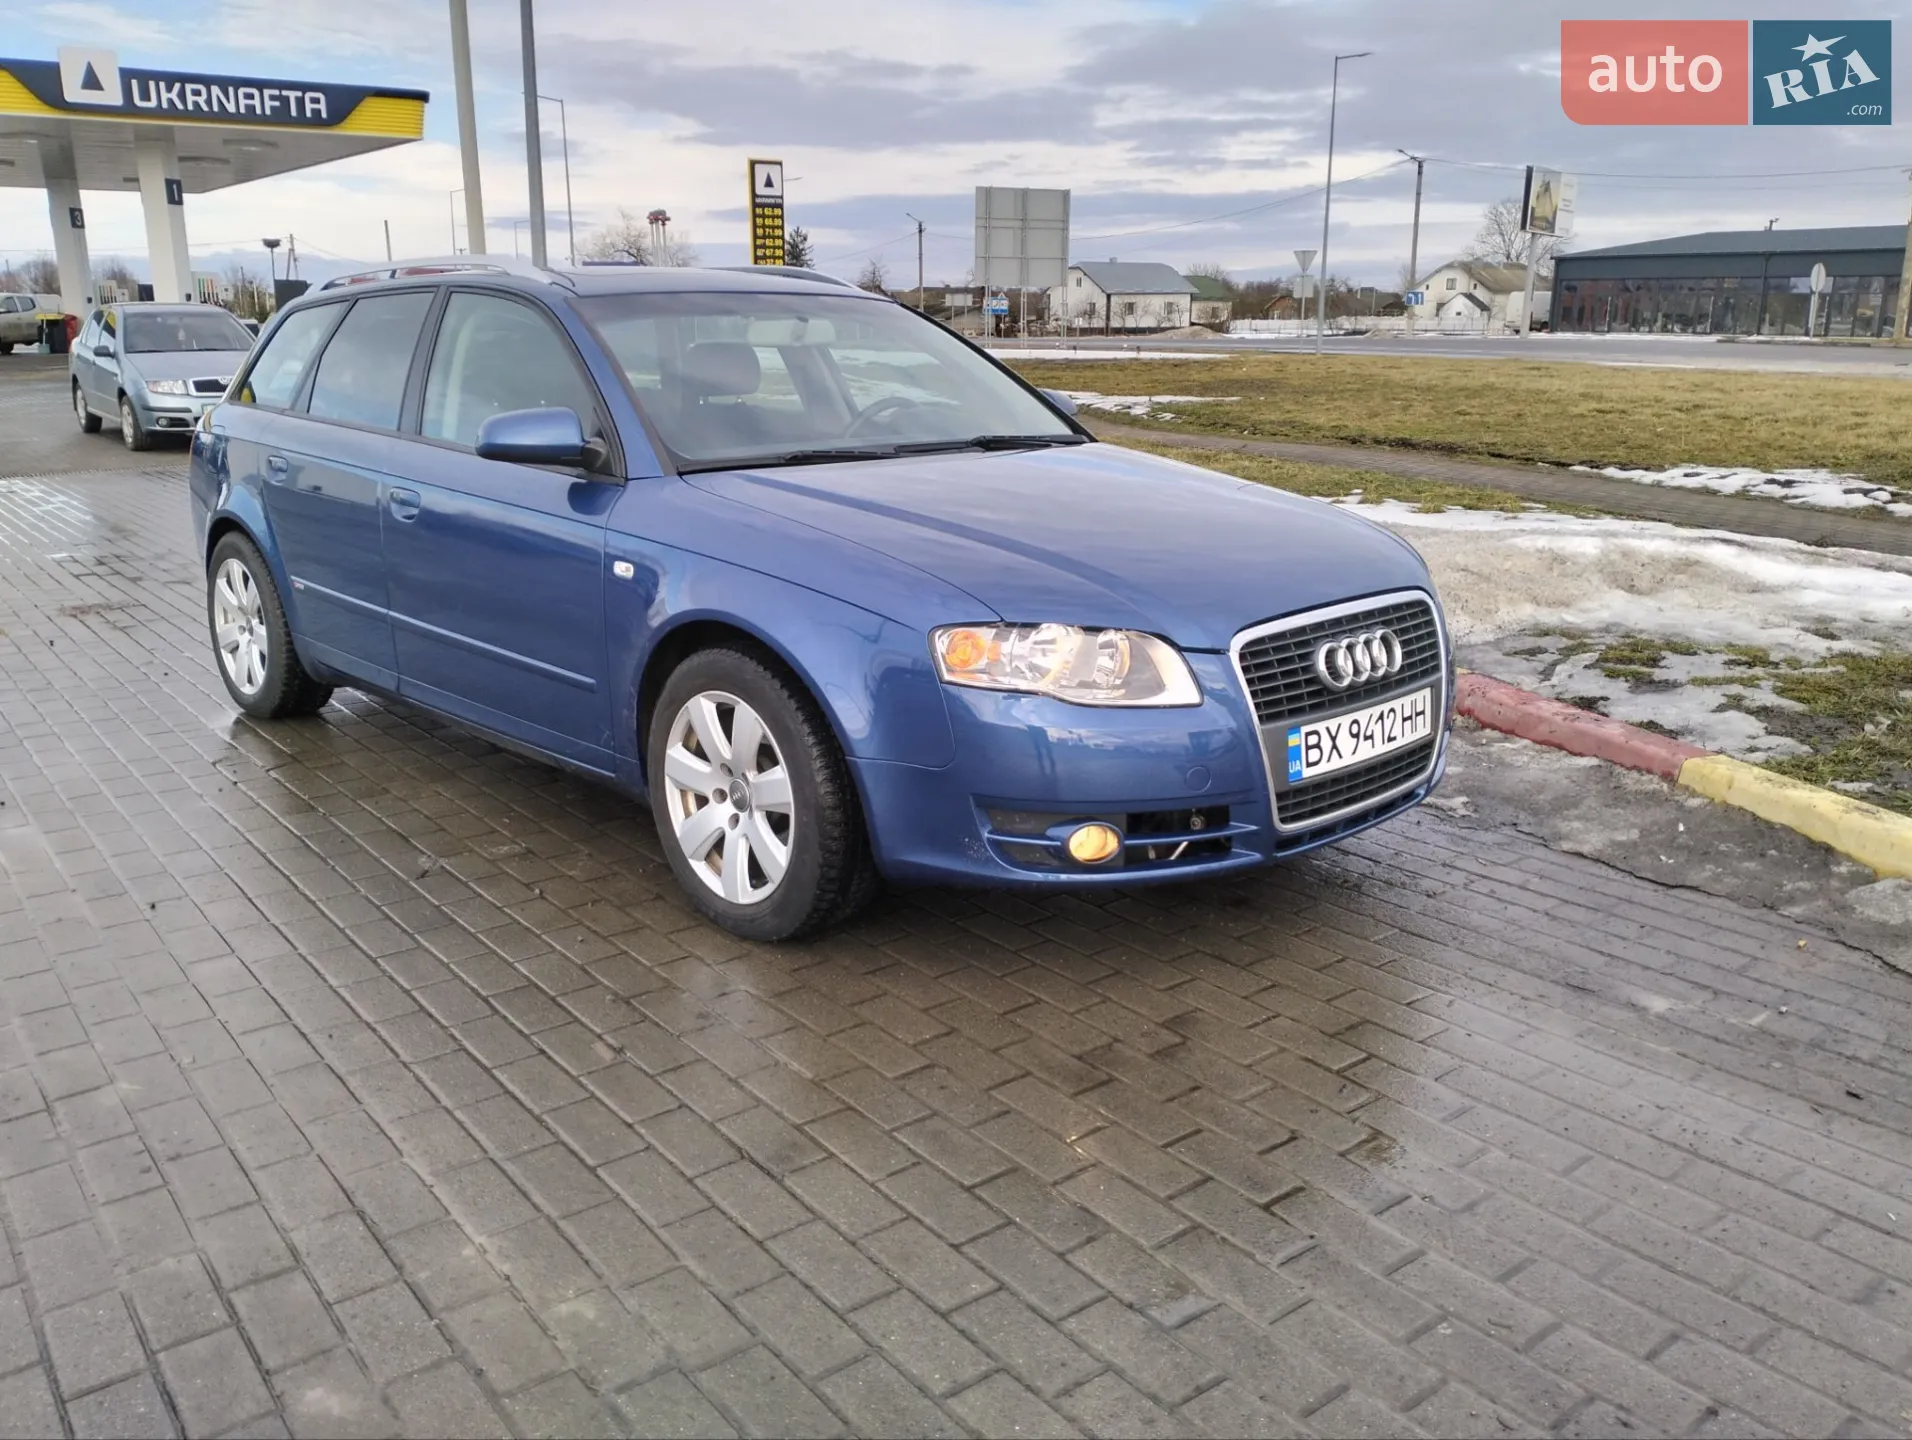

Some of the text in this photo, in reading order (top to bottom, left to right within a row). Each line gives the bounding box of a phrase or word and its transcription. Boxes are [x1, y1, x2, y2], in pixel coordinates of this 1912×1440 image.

[130, 79, 328, 119] UKRNAFTA
[172, 183, 179, 202] 1
[74, 211, 82, 226] 3
[1304, 694, 1426, 769] BX 9412 HH
[1288, 761, 1301, 773] UA
